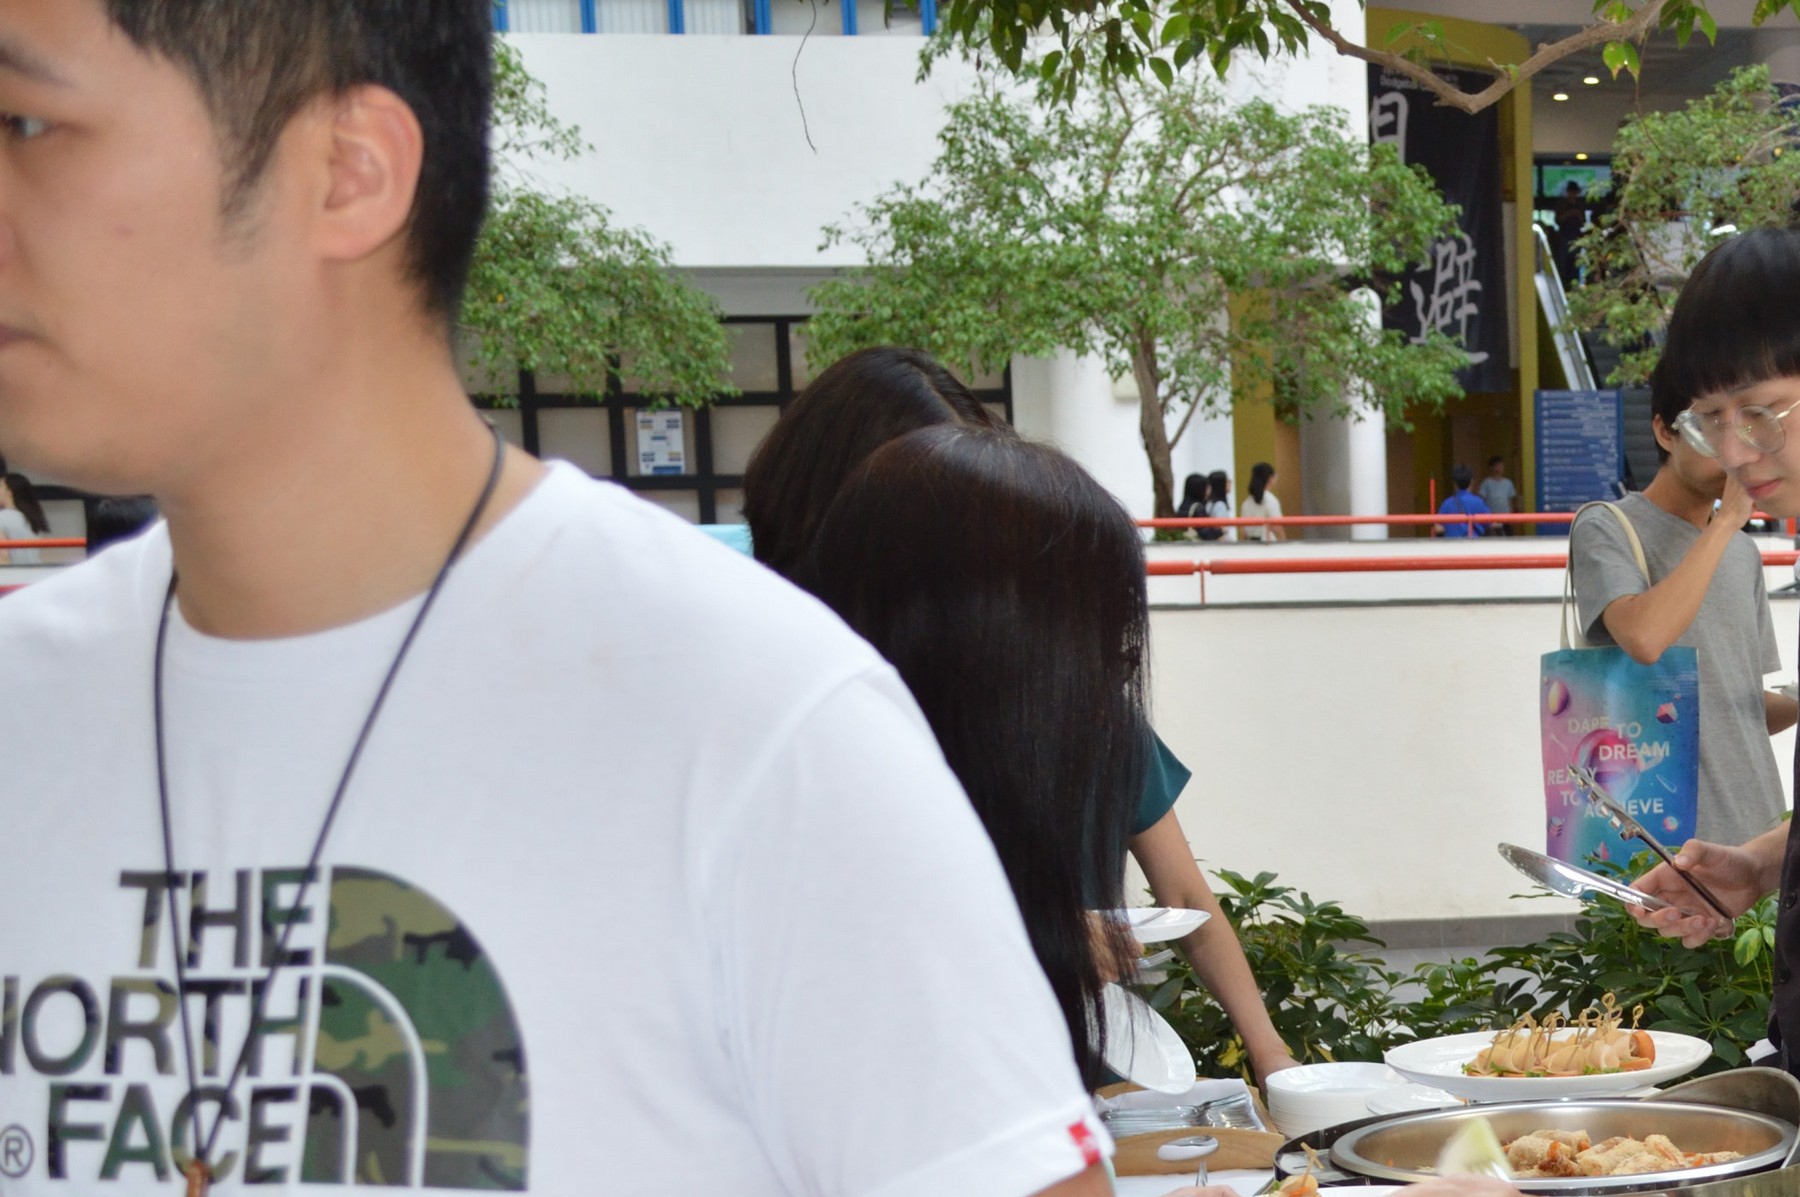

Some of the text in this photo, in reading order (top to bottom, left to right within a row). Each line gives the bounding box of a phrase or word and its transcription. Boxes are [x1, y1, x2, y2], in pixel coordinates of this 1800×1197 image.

[1616, 721, 1642, 738] TO
[1599, 741, 1670, 761] DREAM
[1548, 767, 1597, 785] REY
[1584, 798, 1664, 817] ACIEVE
[119, 866, 319, 968] THE
[47, 1081, 299, 1184] FACE
